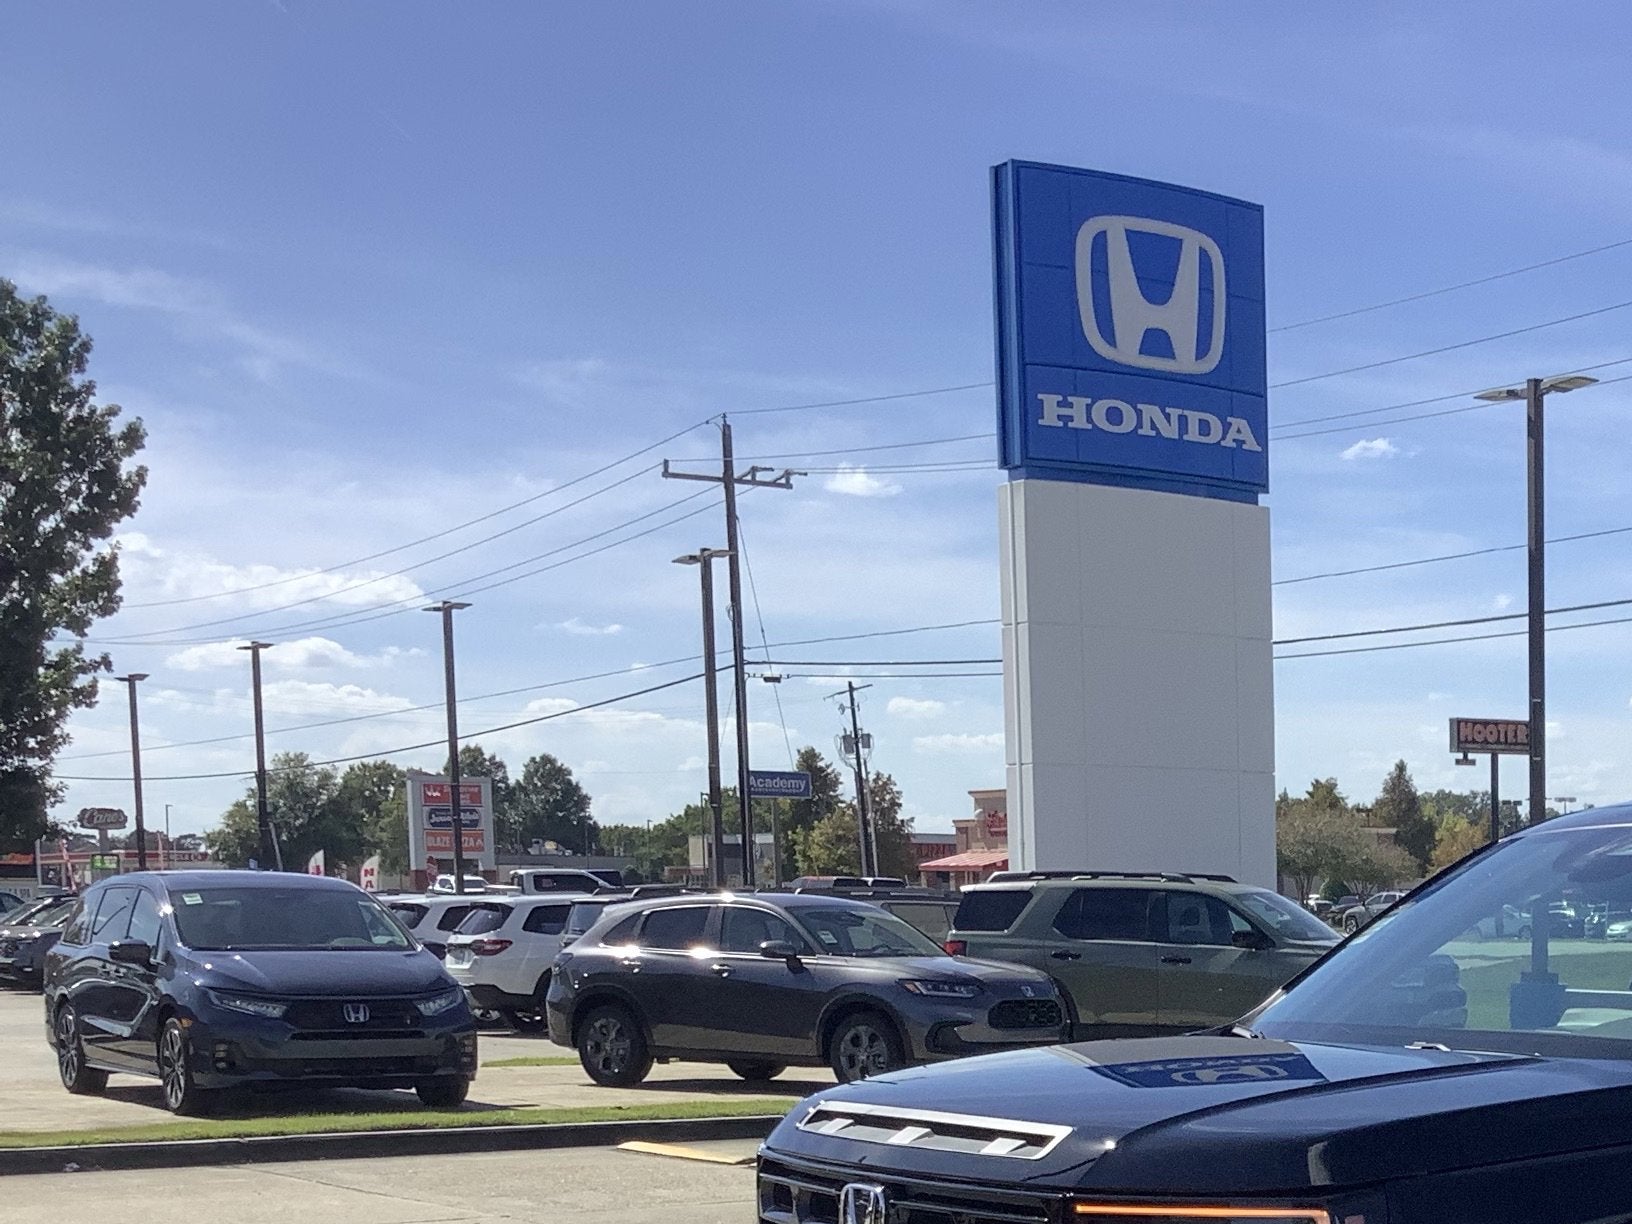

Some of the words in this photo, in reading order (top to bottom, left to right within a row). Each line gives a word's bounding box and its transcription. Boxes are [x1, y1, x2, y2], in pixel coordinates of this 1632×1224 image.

[1037, 393, 1262, 452] HONDA
[1460, 721, 1530, 744] HOOTER
[750, 775, 806, 792] Academy
